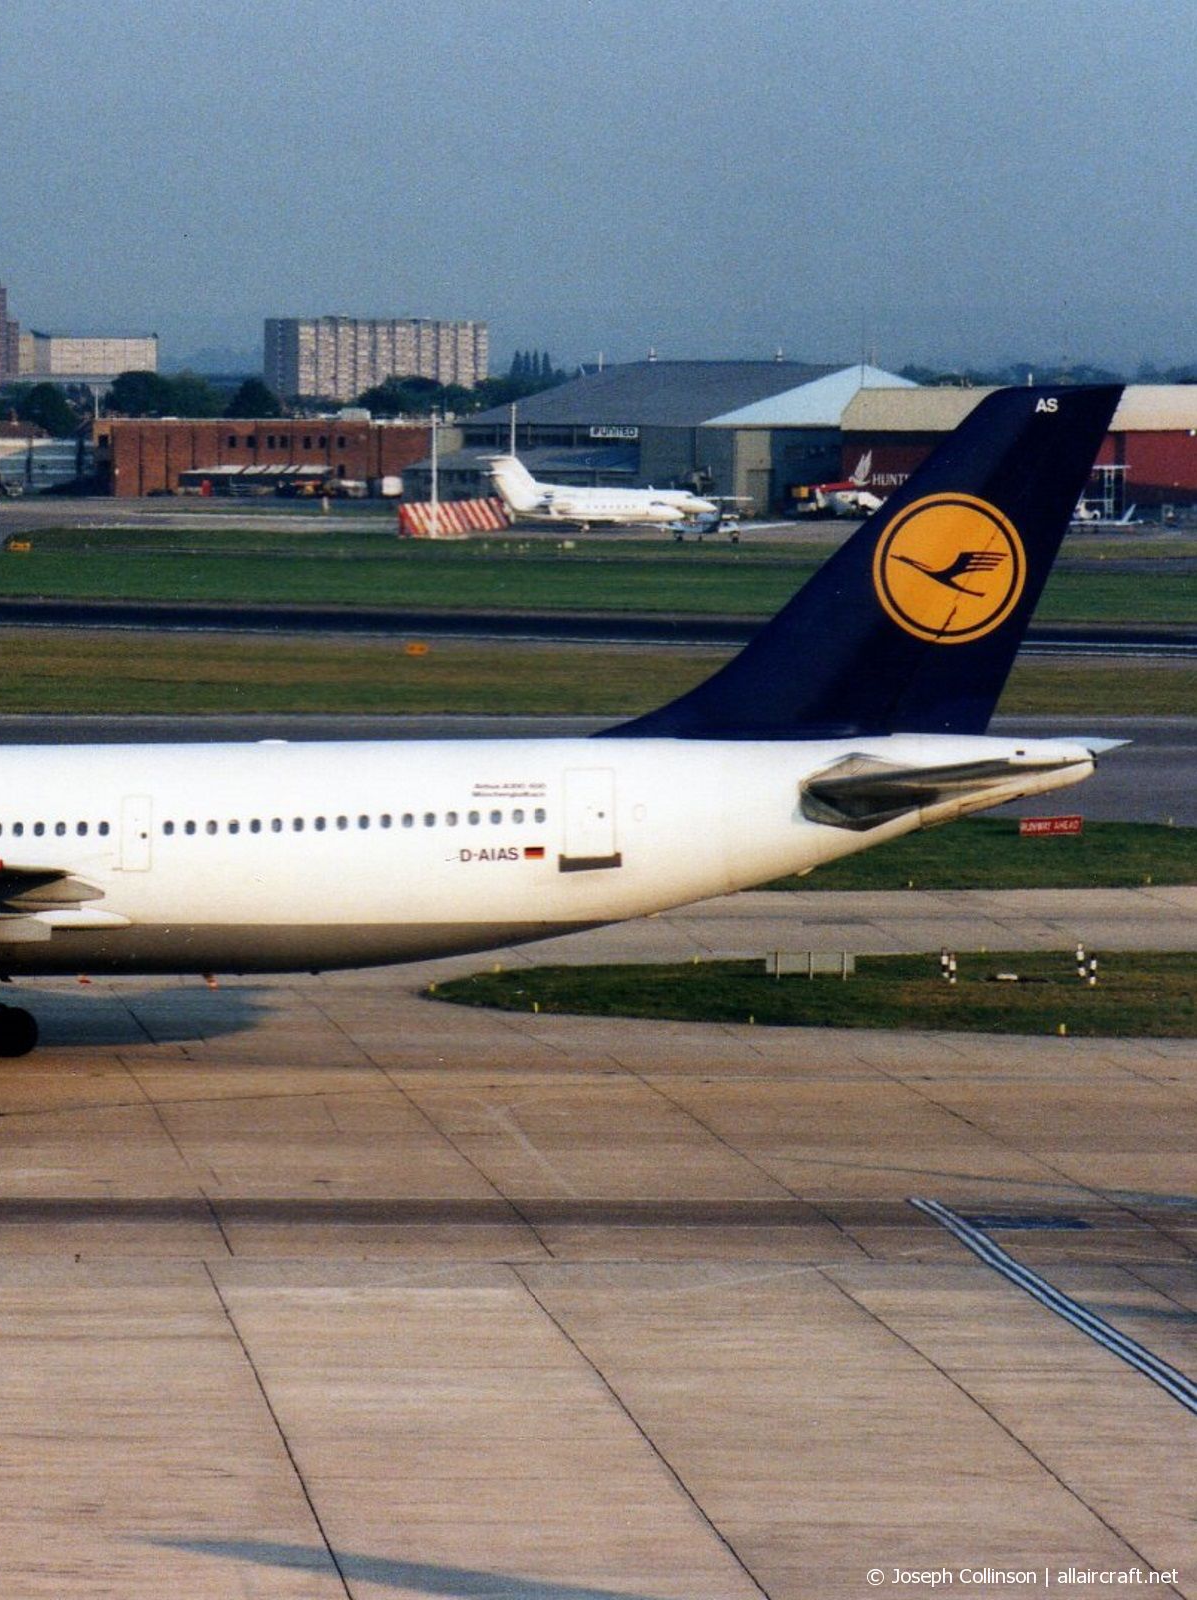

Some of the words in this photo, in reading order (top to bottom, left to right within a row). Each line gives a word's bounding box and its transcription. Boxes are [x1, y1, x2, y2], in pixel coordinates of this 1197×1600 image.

[1035, 398, 1058, 412] AS
[872, 473, 910, 486] HUNT
[1020, 822, 1051, 832] RUNWAY
[1053, 820, 1080, 830] AHEAD
[460, 847, 519, 862] D-AIAS
